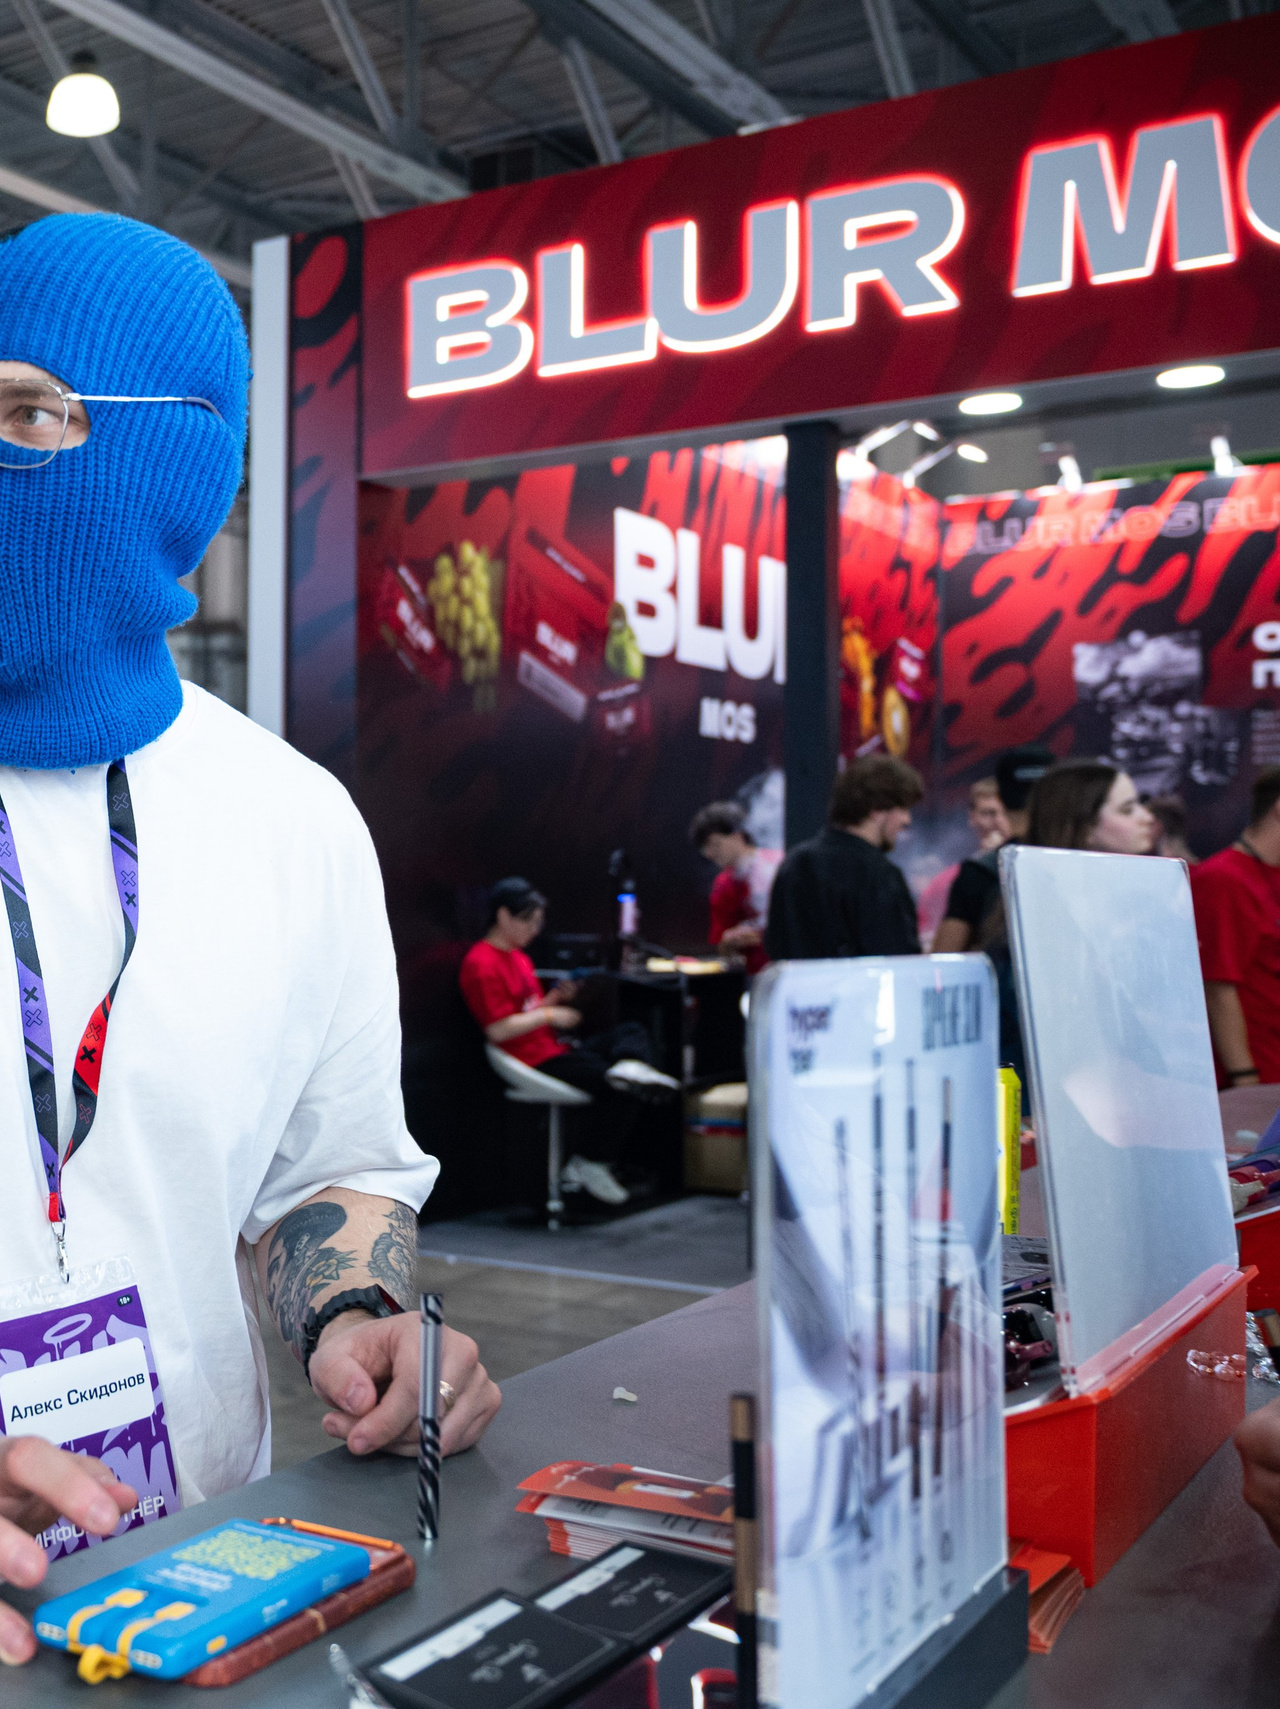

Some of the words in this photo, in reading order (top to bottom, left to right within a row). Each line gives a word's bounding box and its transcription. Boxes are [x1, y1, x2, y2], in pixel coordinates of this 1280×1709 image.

[407, 174, 967, 398] BLUR
[613, 506, 787, 686] BLU
[699, 697, 757, 743] MOS
[10, 1398, 63, 1422] Алекс
[67, 1373, 145, 1405] Скидонов
